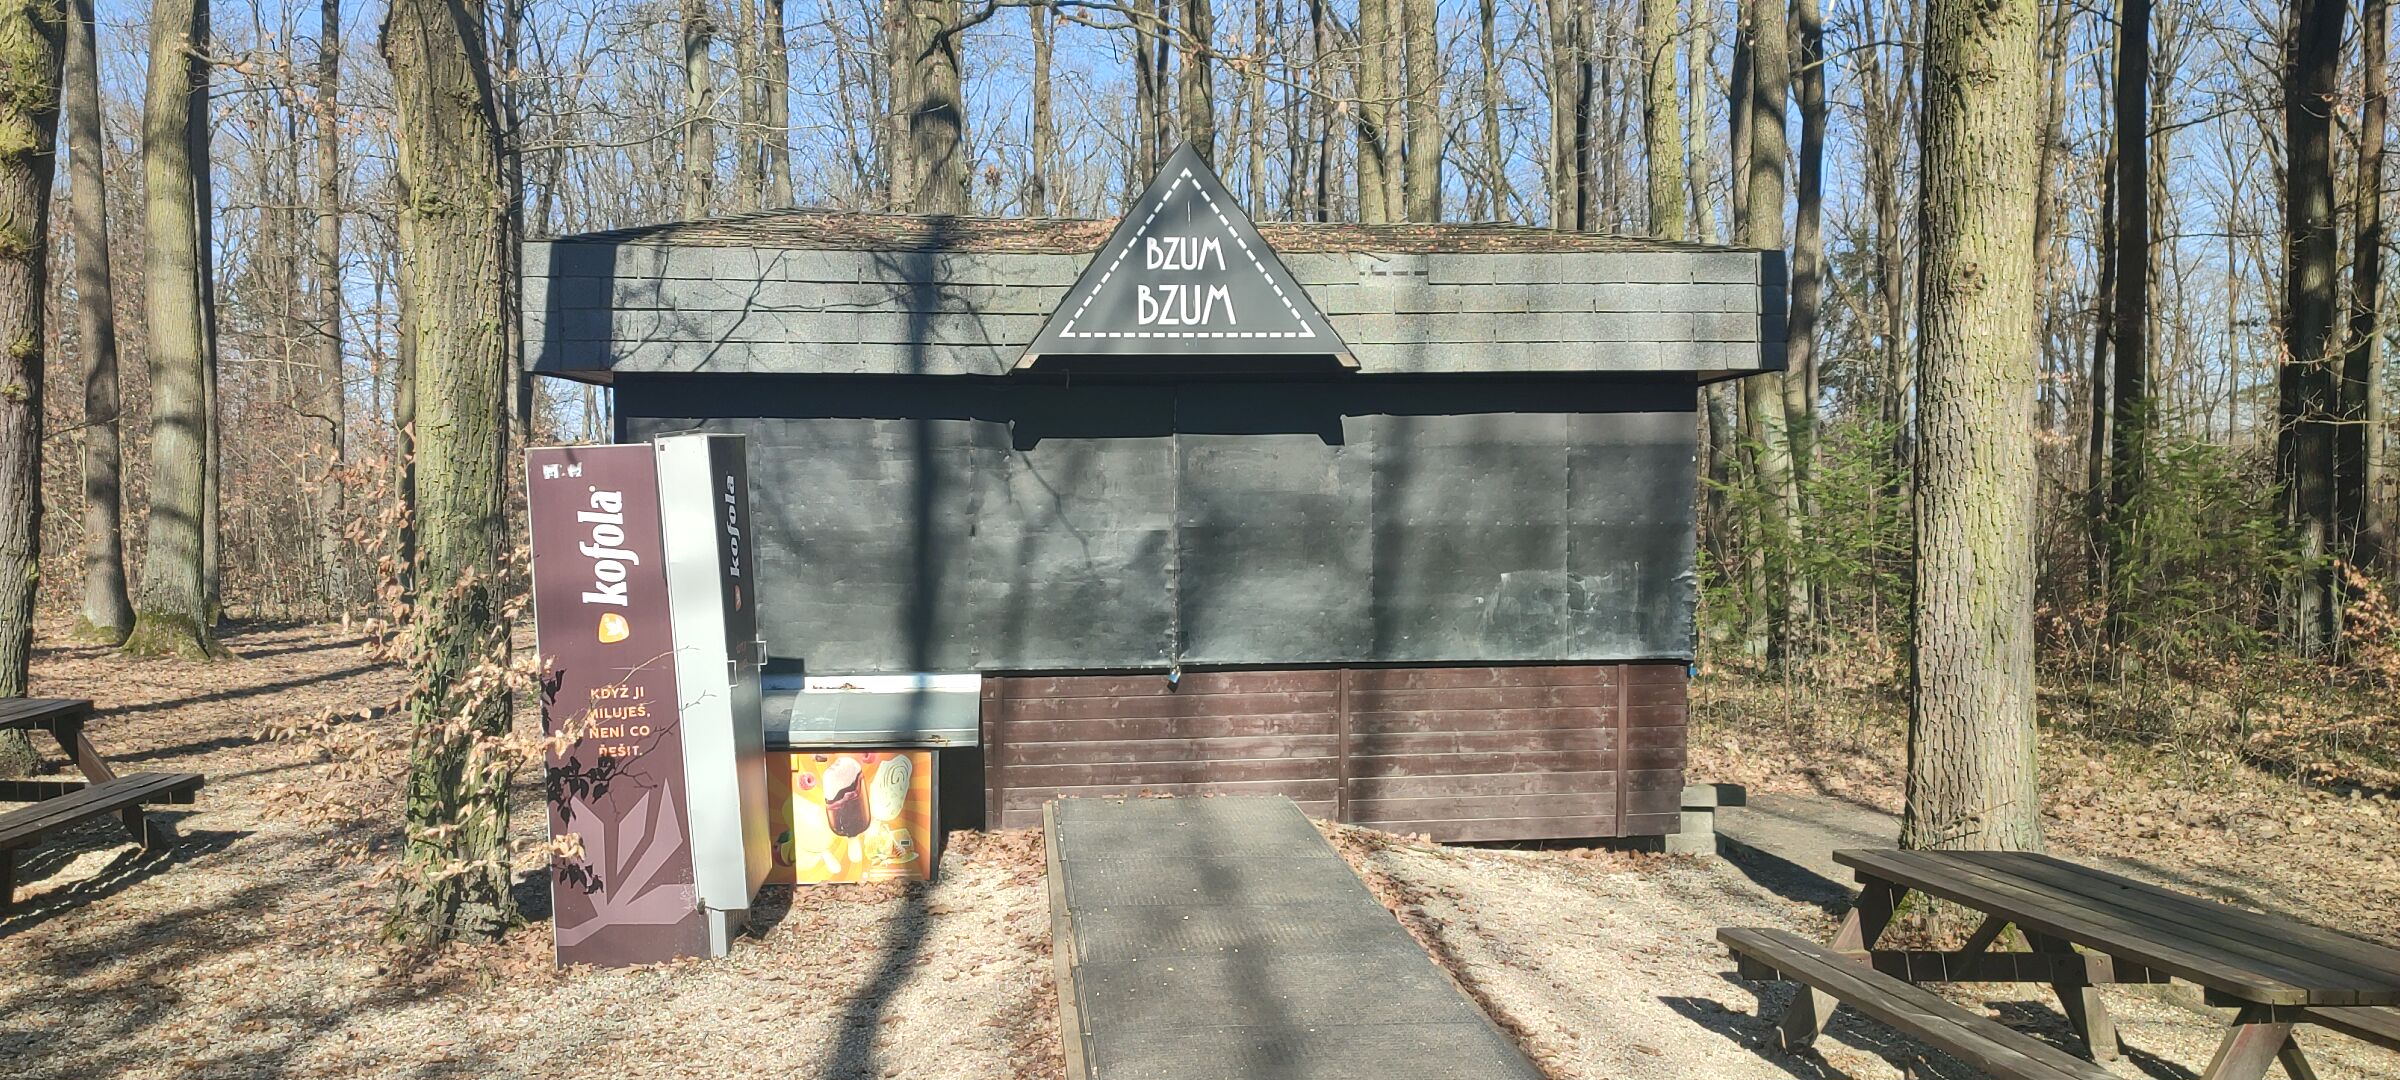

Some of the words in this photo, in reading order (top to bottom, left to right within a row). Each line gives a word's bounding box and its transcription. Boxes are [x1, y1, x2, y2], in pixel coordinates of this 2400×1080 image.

[1146, 236, 1227, 271] BZUM
[1137, 284, 1237, 326] BZUM
[725, 475, 741, 578] kofola
[576, 489, 640, 607] kofola
[590, 684, 629, 699] KDYŽ
[633, 686, 644, 700] JI
[589, 724, 624, 739] NENÍ
[629, 725, 650, 737] CO
